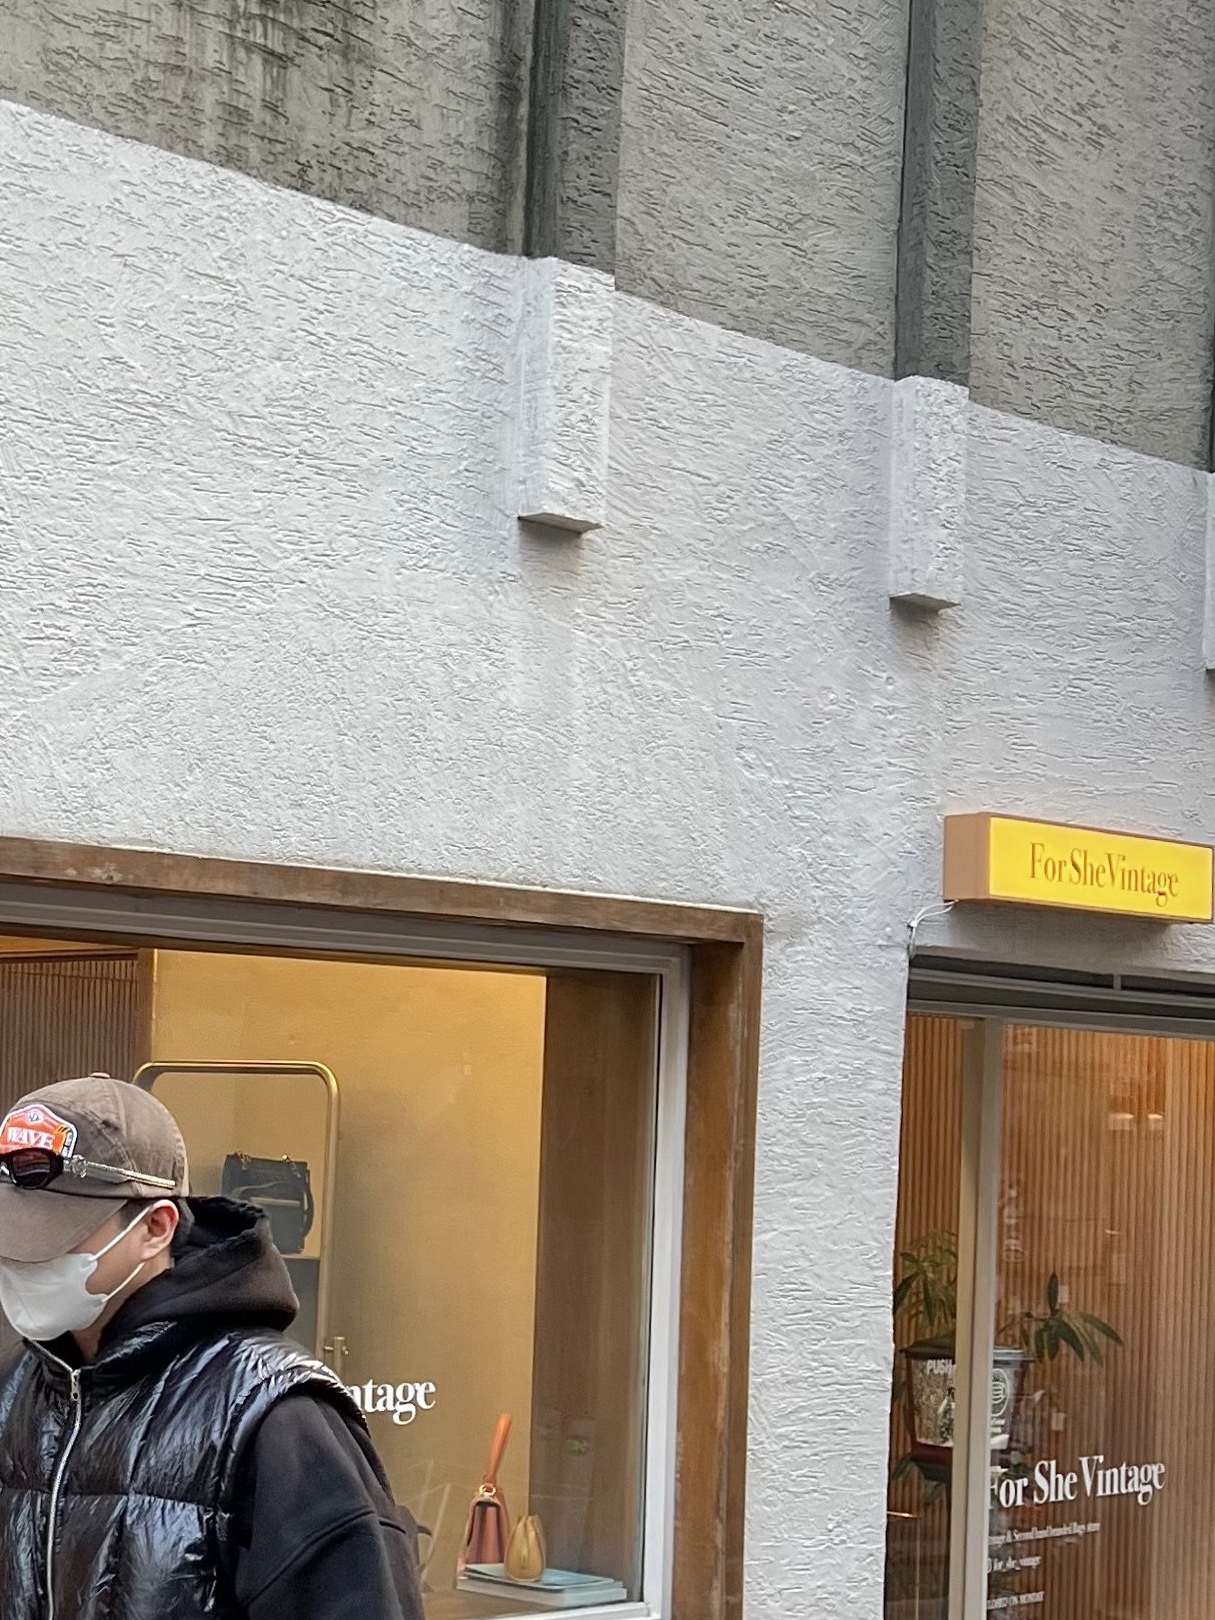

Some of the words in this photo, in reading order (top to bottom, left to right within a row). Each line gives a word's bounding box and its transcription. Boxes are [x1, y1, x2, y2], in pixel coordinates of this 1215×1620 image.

[7, 1127, 55, 1150] WAVE
[345, 1379, 436, 1425] ntage
[1033, 1459, 1078, 1504] She
[1079, 1455, 1166, 1506] Vintage
